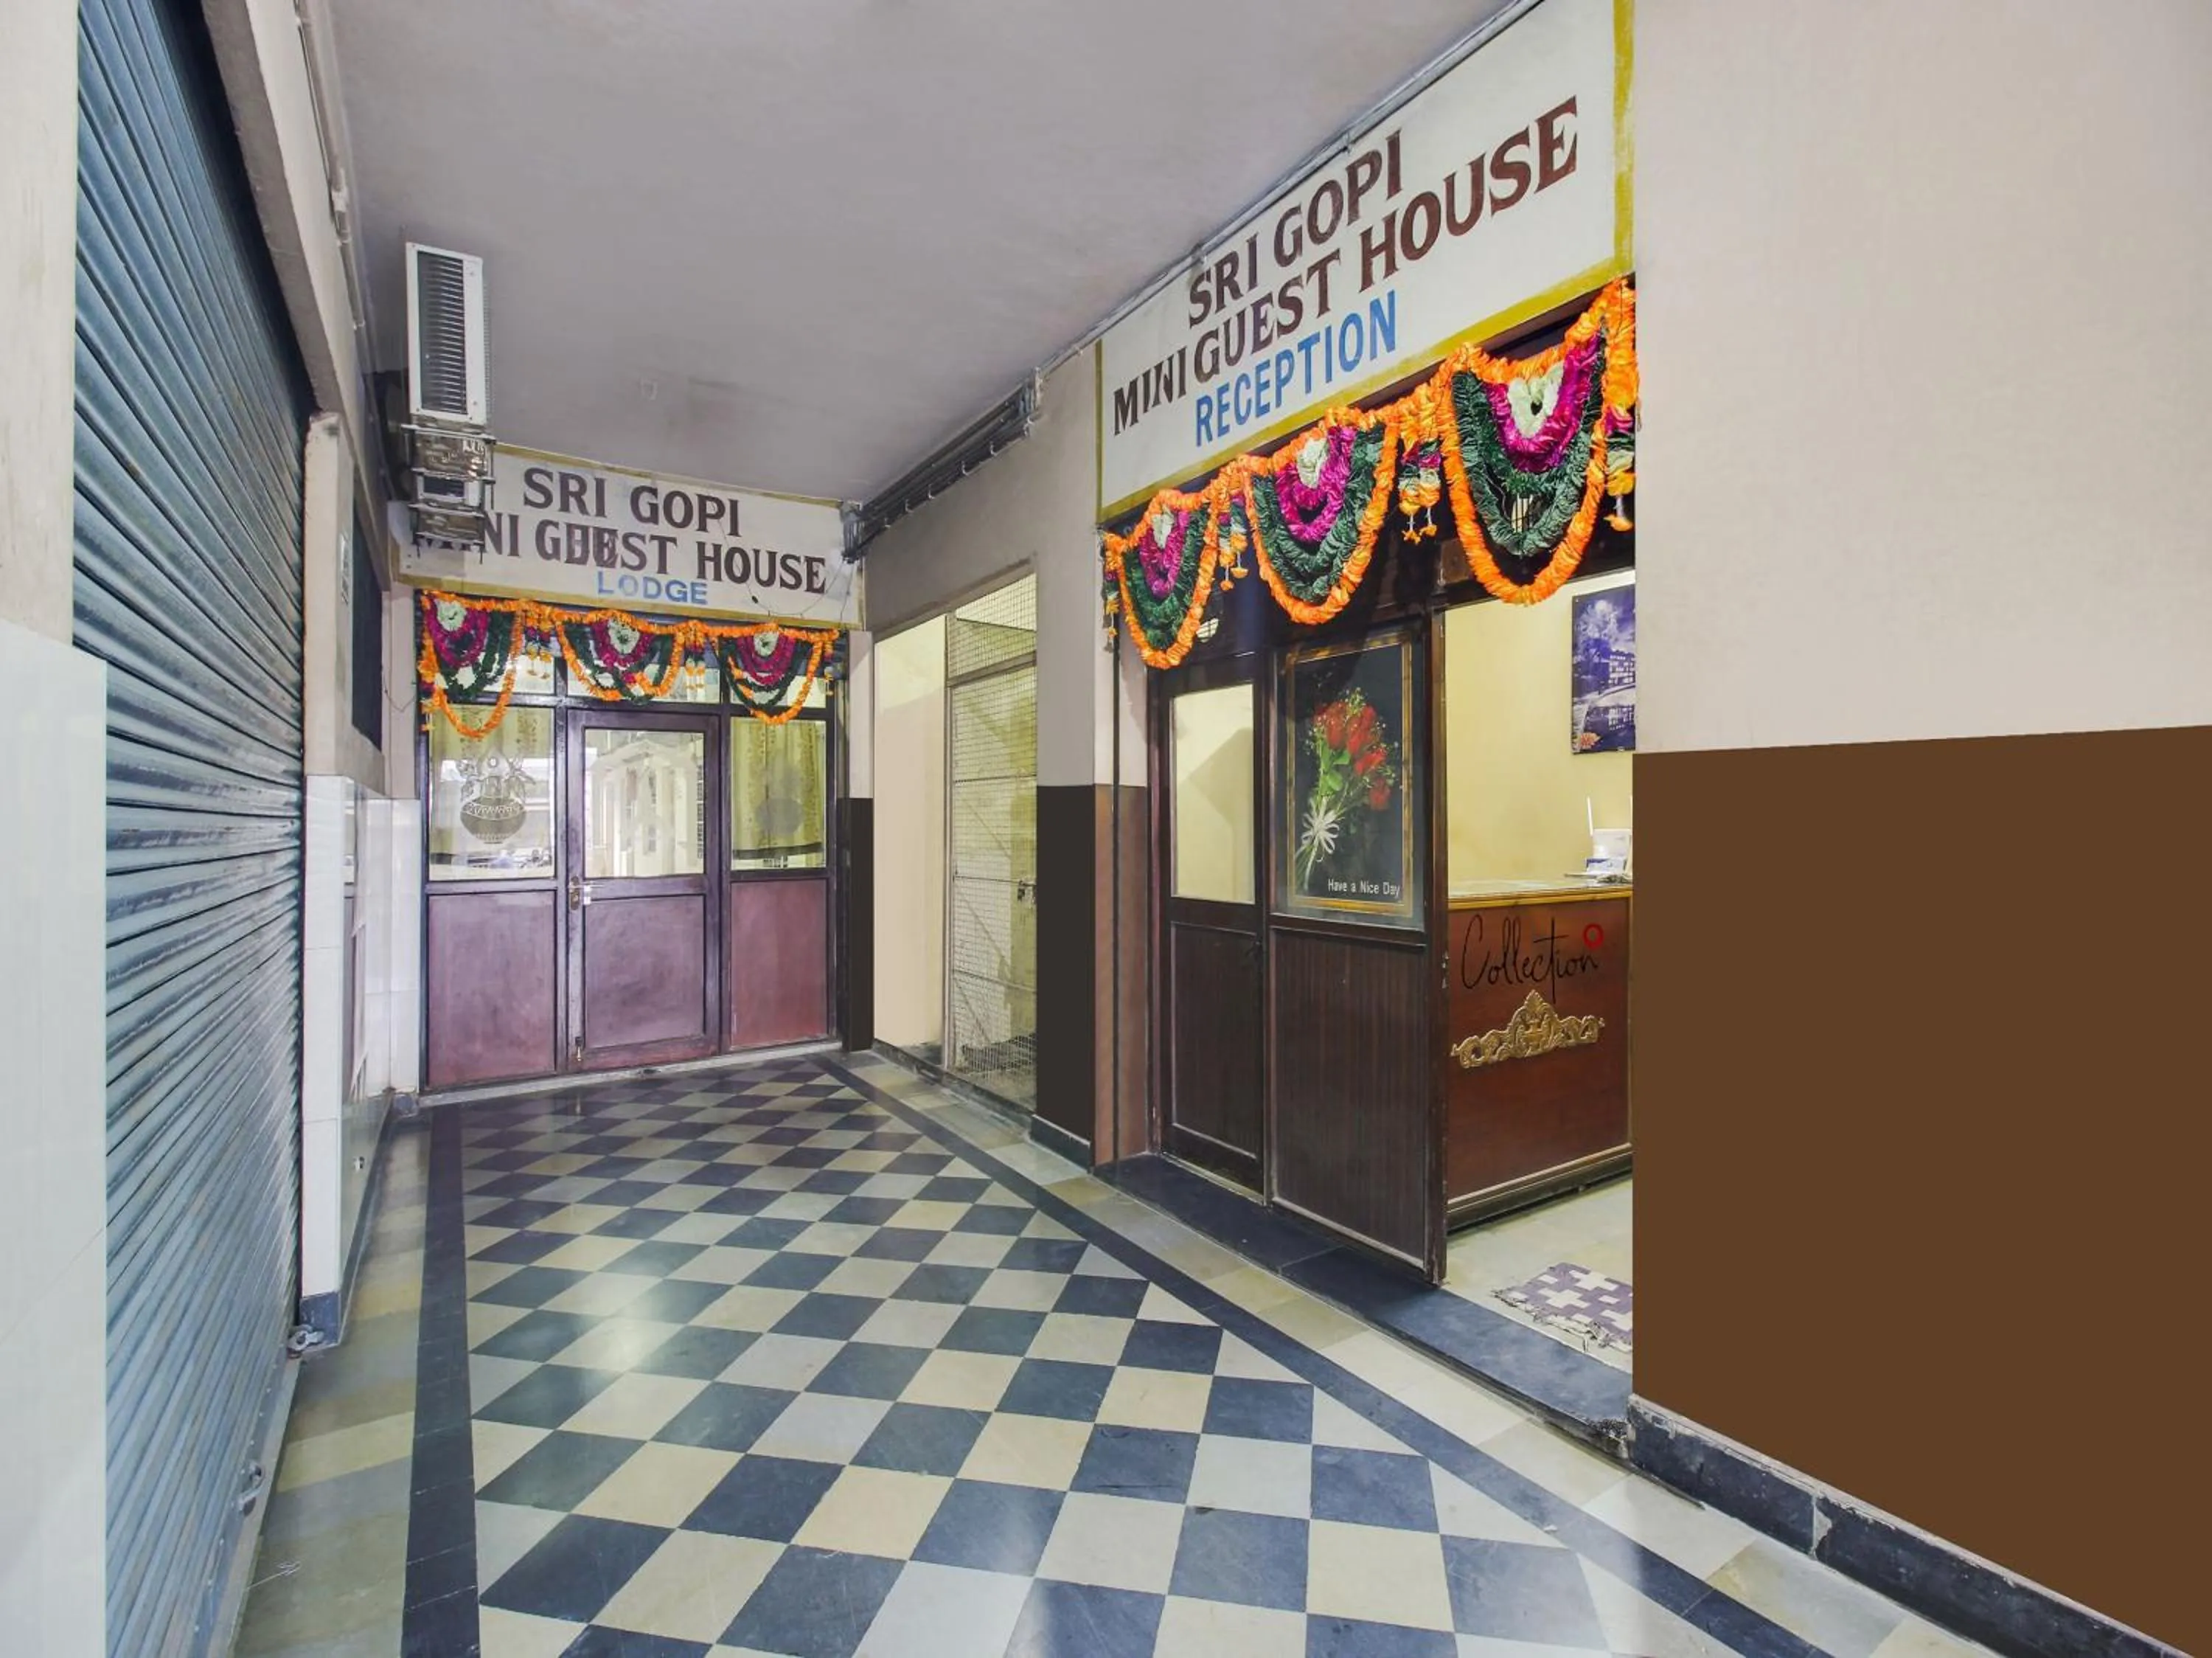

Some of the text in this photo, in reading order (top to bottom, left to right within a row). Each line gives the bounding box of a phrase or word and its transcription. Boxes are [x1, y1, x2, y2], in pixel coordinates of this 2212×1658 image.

[1113, 95, 1577, 437] MINI GUEST HOUSE
[1188, 129, 1402, 330] SRI GOPI
[1195, 290, 1397, 448] RECEPTION
[523, 467, 742, 538] SRI GOPI
[597, 570, 708, 606] LODGE
[696, 541, 827, 594] HOUSE
[1328, 878, 1400, 899] Have a Nice Day
[1461, 914, 1599, 1005] Collection
